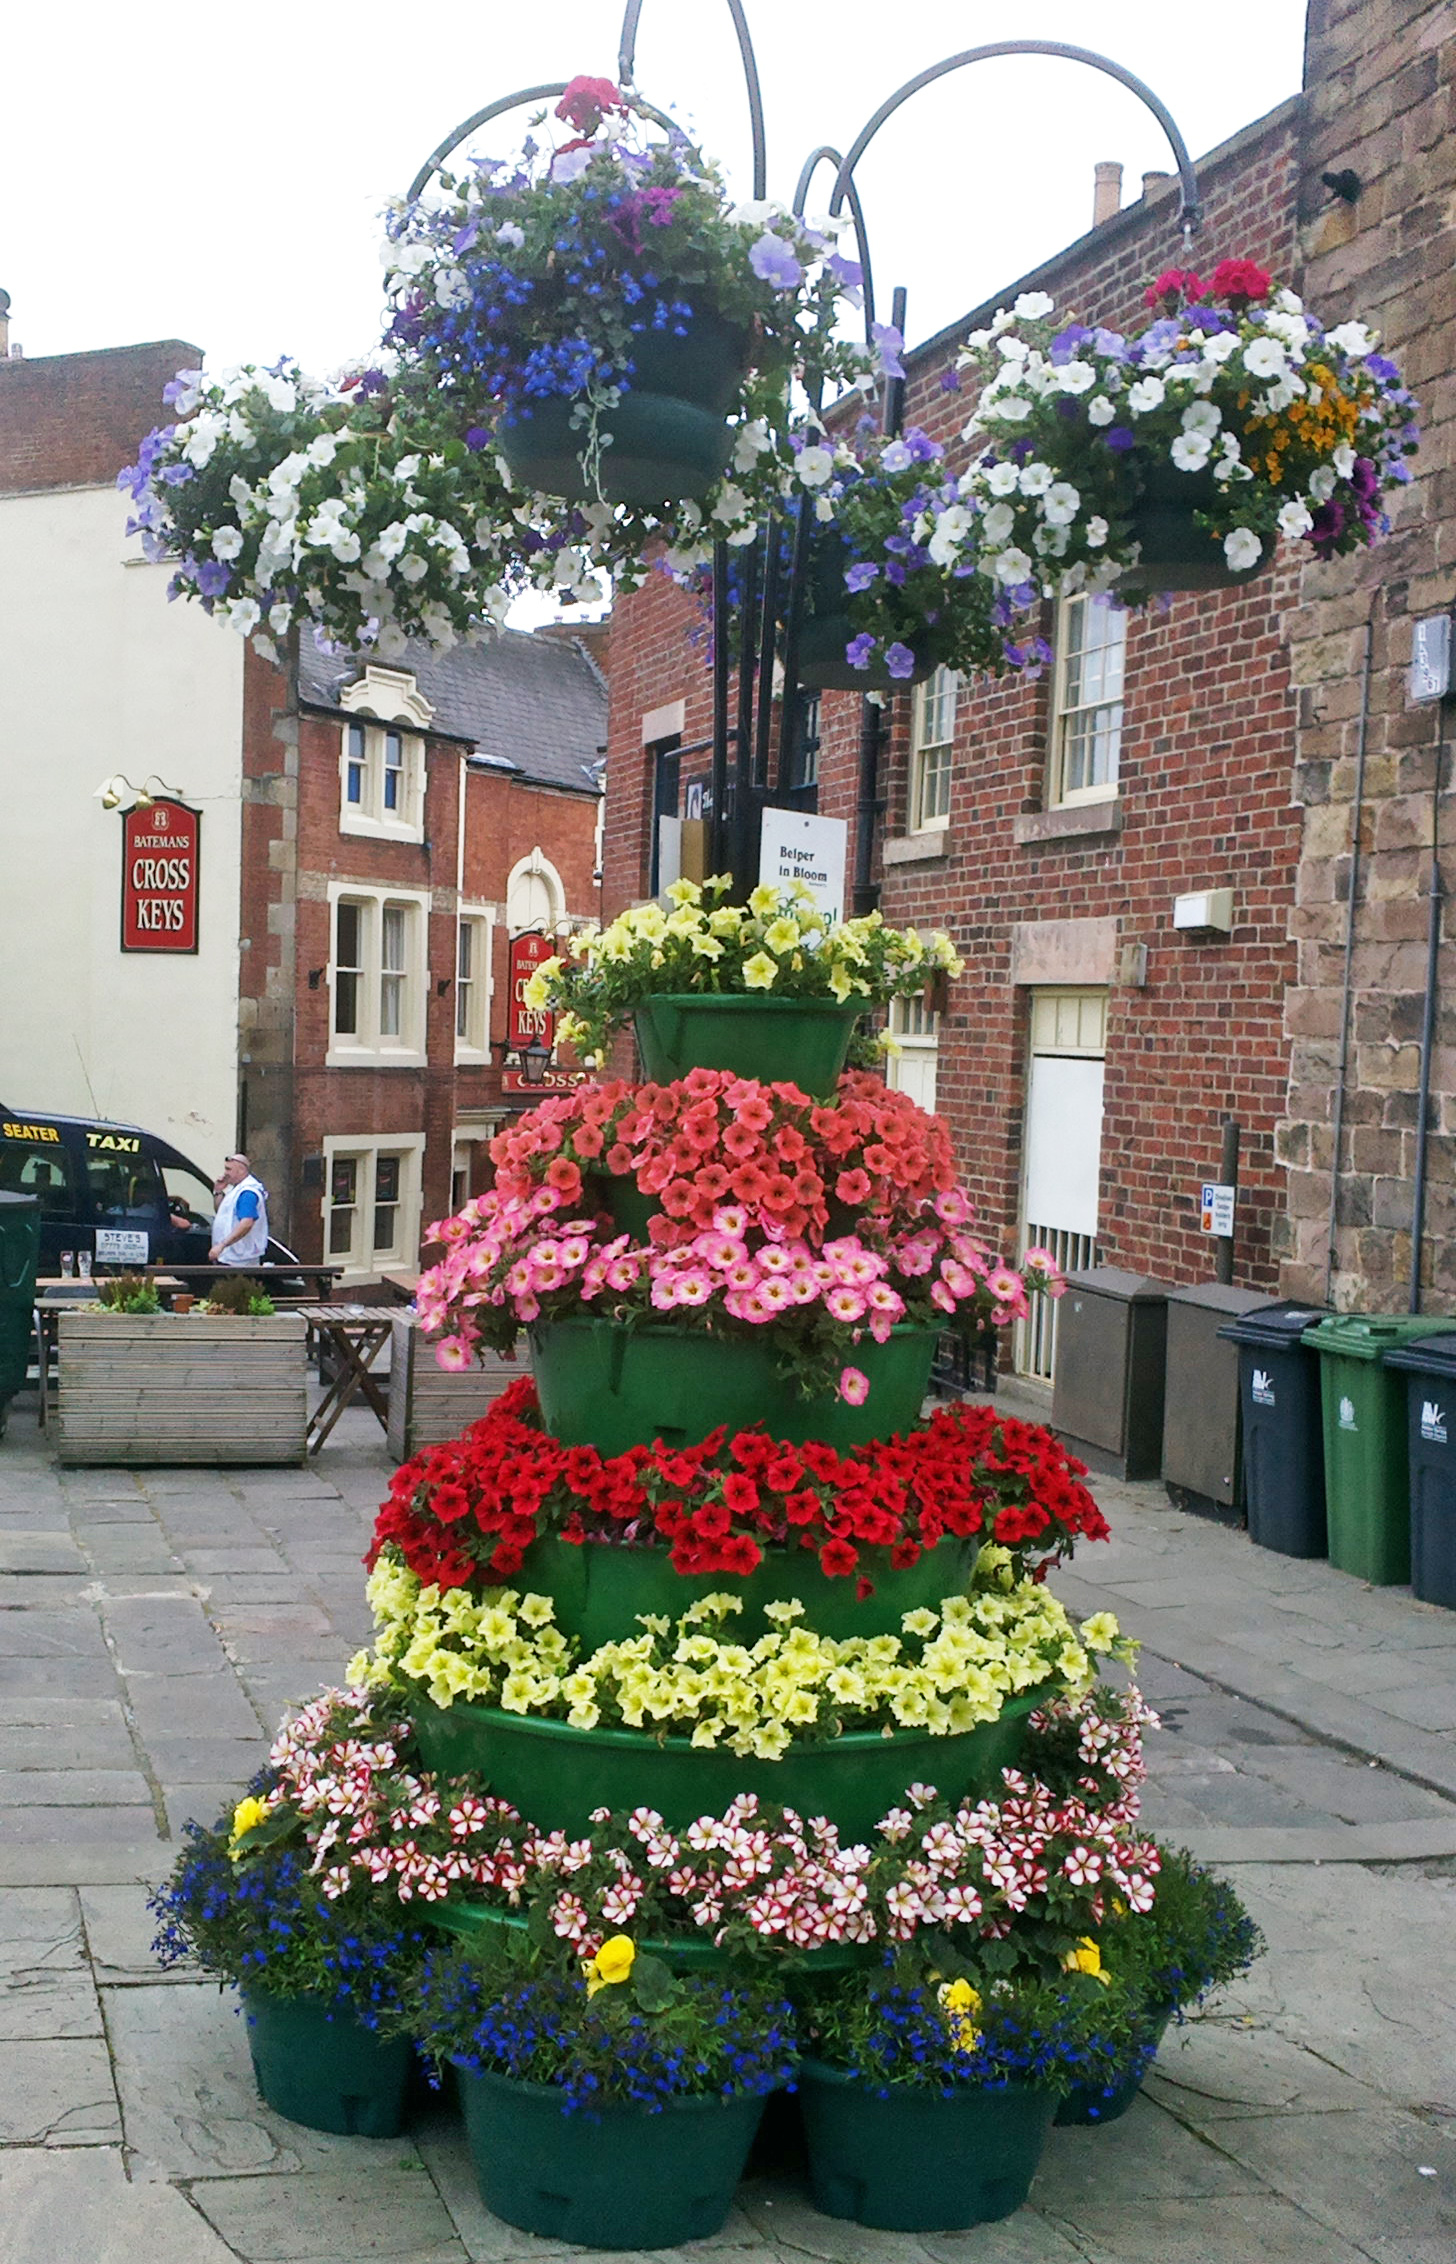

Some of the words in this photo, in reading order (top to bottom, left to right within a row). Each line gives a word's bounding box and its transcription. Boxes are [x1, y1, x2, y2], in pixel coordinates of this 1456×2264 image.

[134, 835, 190, 849] BATEMANS
[780, 846, 815, 862] Belper
[133, 858, 190, 890] CROSS
[793, 866, 828, 882] Bloom
[137, 899, 184, 931] KEYS
[518, 1010, 547, 1036] KEYS
[517, 1074, 579, 1088] COSS
[2, 1122, 60, 1142] SEATER
[85, 1132, 140, 1153] TAXI
[1205, 1188, 1213, 1206] P
